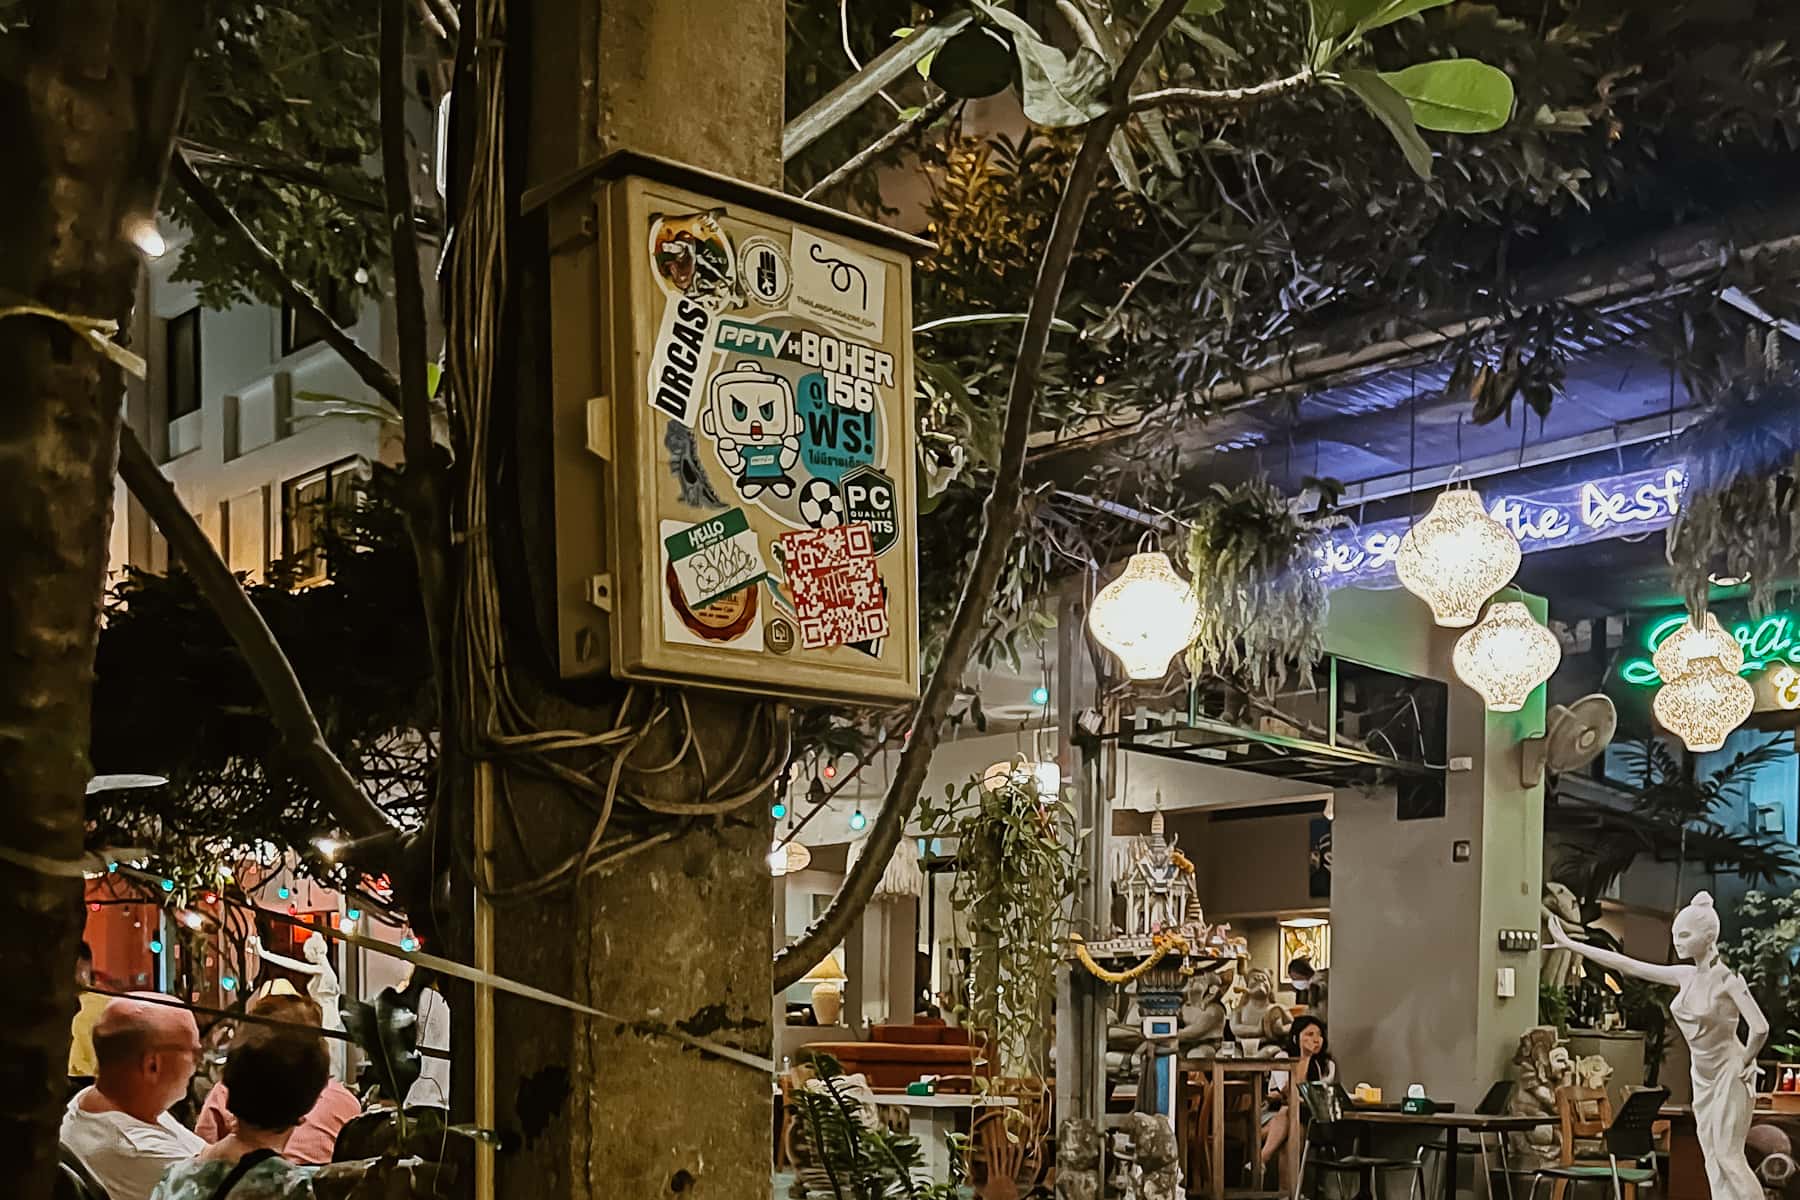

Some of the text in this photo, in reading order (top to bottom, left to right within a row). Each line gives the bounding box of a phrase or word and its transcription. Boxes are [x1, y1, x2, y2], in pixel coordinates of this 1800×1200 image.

[655, 299, 709, 420] DRCAS
[718, 325, 791, 358] PPTV
[801, 330, 895, 387] BOHER
[823, 370, 875, 413] 156
[847, 485, 891, 510] PC
[688, 520, 725, 547] HELLO
